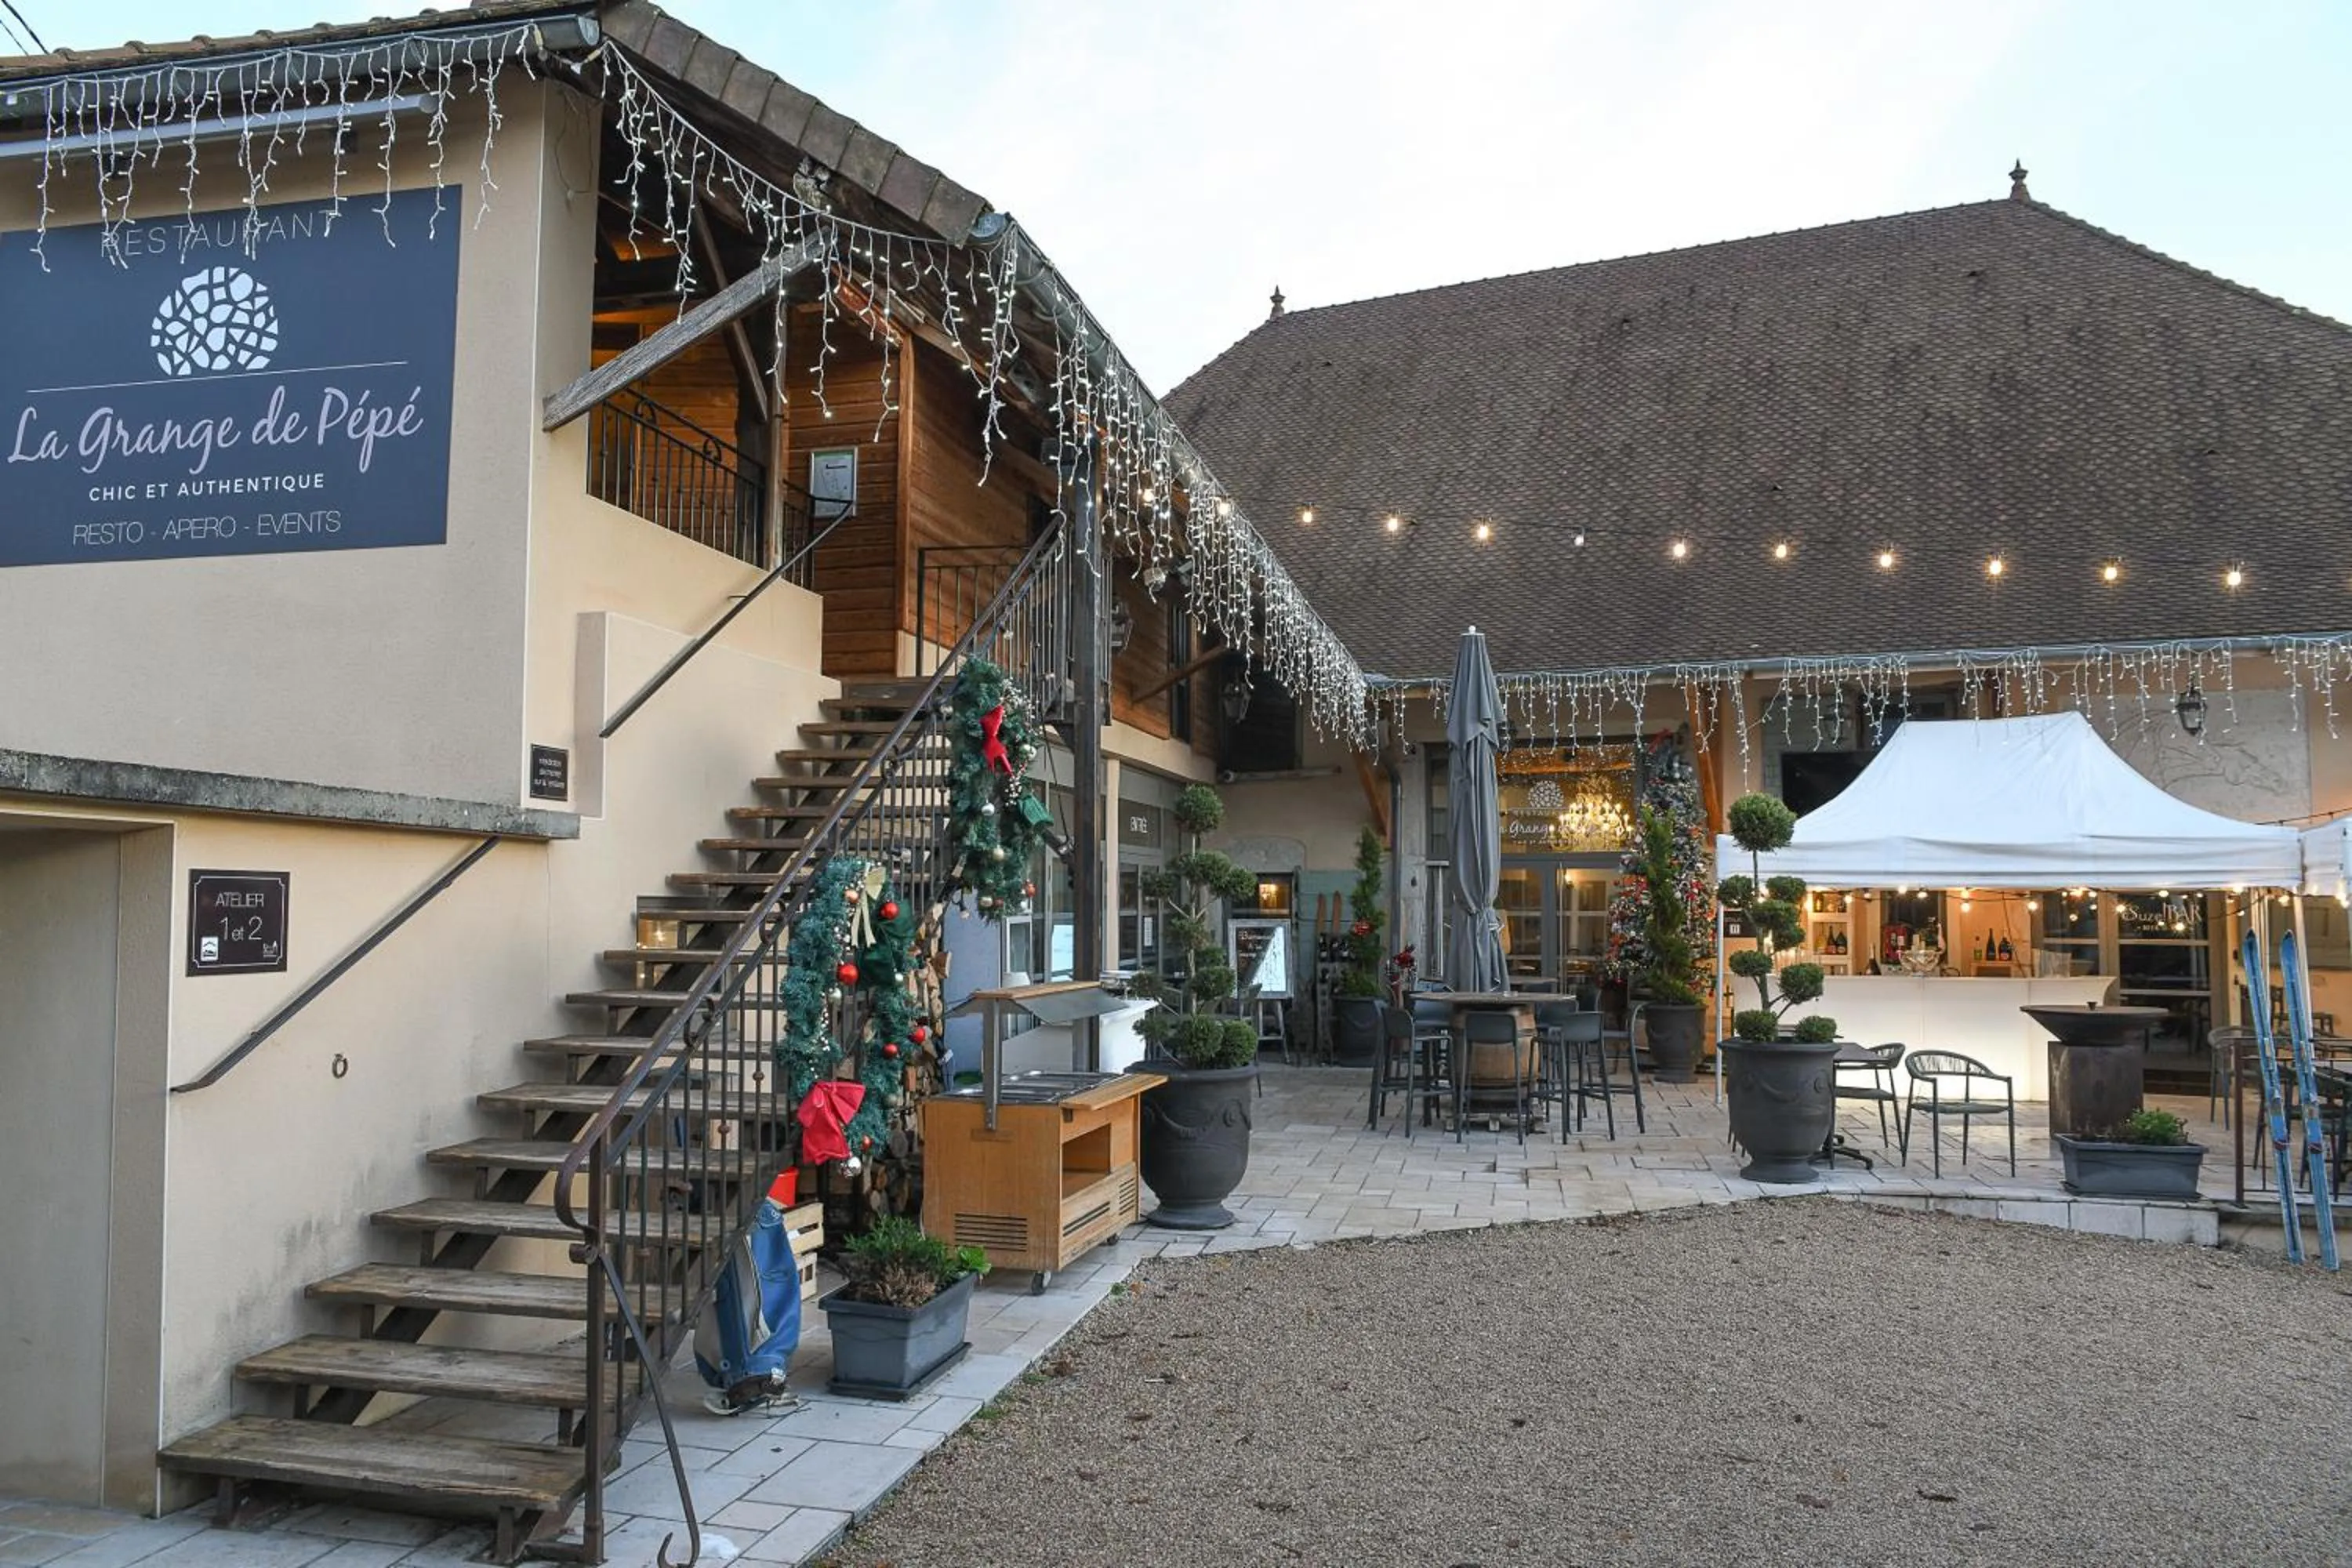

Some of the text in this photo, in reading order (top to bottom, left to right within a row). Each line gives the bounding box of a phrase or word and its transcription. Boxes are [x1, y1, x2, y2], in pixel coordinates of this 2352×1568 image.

[7, 385, 424, 474] La Grange de Pépé
[89, 473, 325, 502] CHIC ET AUTHENTIQUE
[73, 521, 144, 546] RESTO
[162, 516, 236, 541] APERO
[258, 510, 342, 536] EVENTS
[214, 891, 265, 908] ATELIER
[219, 914, 263, 942] 1 et 2
